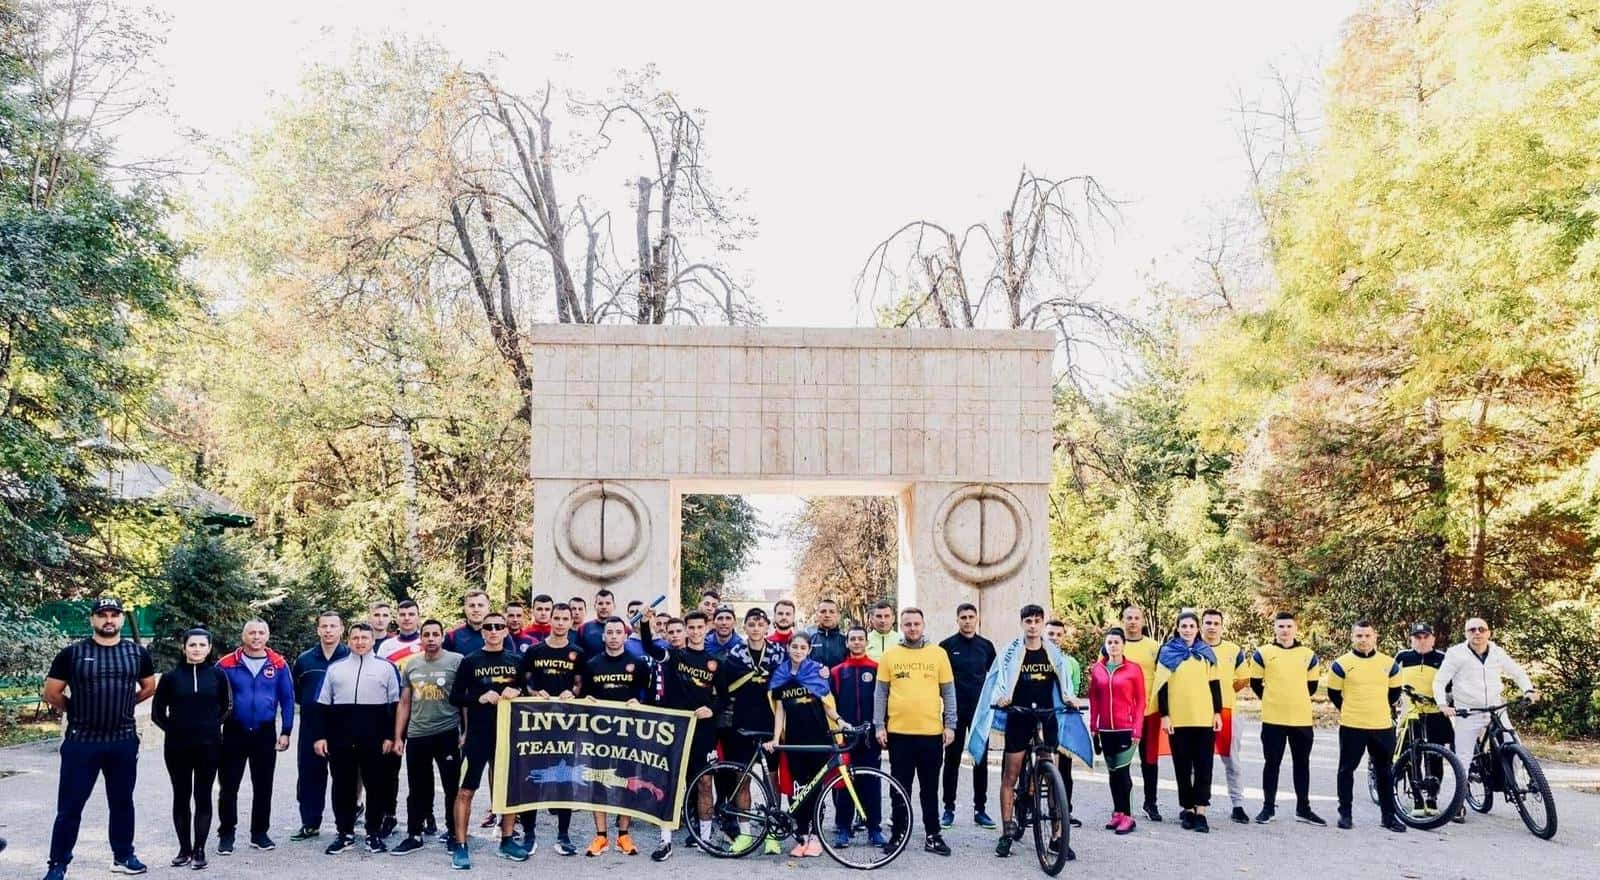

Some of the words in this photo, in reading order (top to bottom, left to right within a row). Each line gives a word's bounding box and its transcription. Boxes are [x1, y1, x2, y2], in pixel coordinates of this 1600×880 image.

[534, 659, 574, 670] INVICTUS
[894, 662, 935, 672] INVICTUS
[475, 665, 517, 677] INVICTUS
[678, 663, 713, 681] INVICTUS
[593, 673, 633, 682] INVICTUS
[518, 710, 675, 746] INVICTUS
[516, 741, 575, 756] TEAM
[581, 742, 670, 772] ROMANIA
